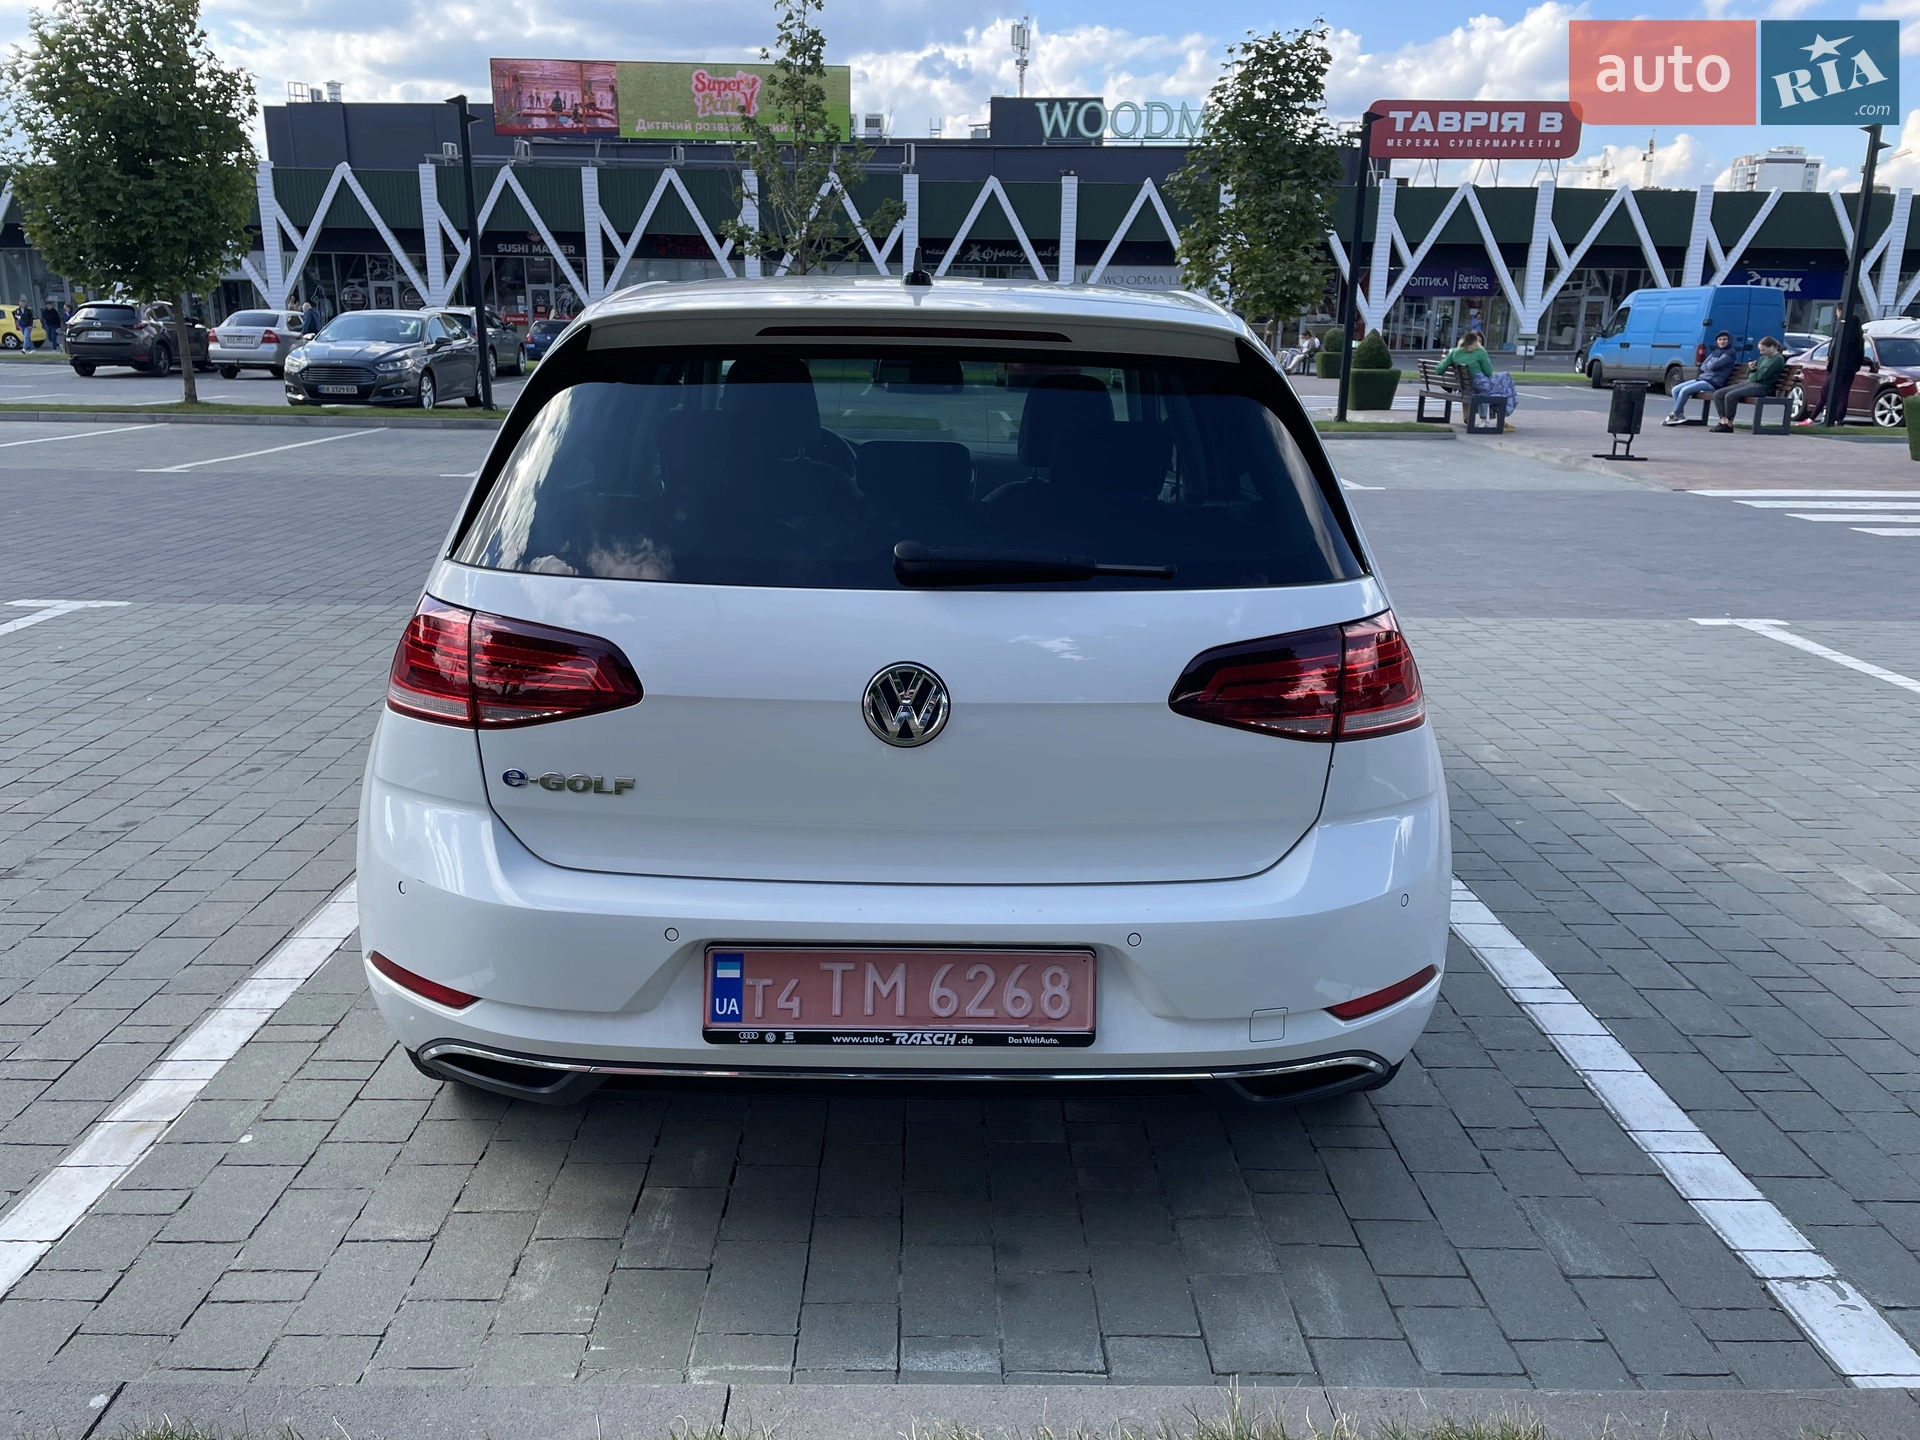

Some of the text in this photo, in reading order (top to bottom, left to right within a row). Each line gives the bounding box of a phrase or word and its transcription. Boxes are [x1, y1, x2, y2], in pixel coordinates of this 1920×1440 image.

[694, 72, 744, 98] Super
[636, 119, 693, 132] Дитячий
[1388, 111, 1564, 133] ТАВРІЯ В
[1386, 138, 1562, 148] МЕРЕЖА СУПЕРМАРКЕТІВ
[497, 243, 576, 255] SUSHI MAER
[1408, 276, 1449, 287] ОПТИКА
[1458, 273, 1487, 283] Retina
[1457, 281, 1490, 290] service
[502, 767, 636, 796] e-GOLF
[745, 961, 1071, 1020] T4 TM 6268
[715, 998, 740, 1015] UA
